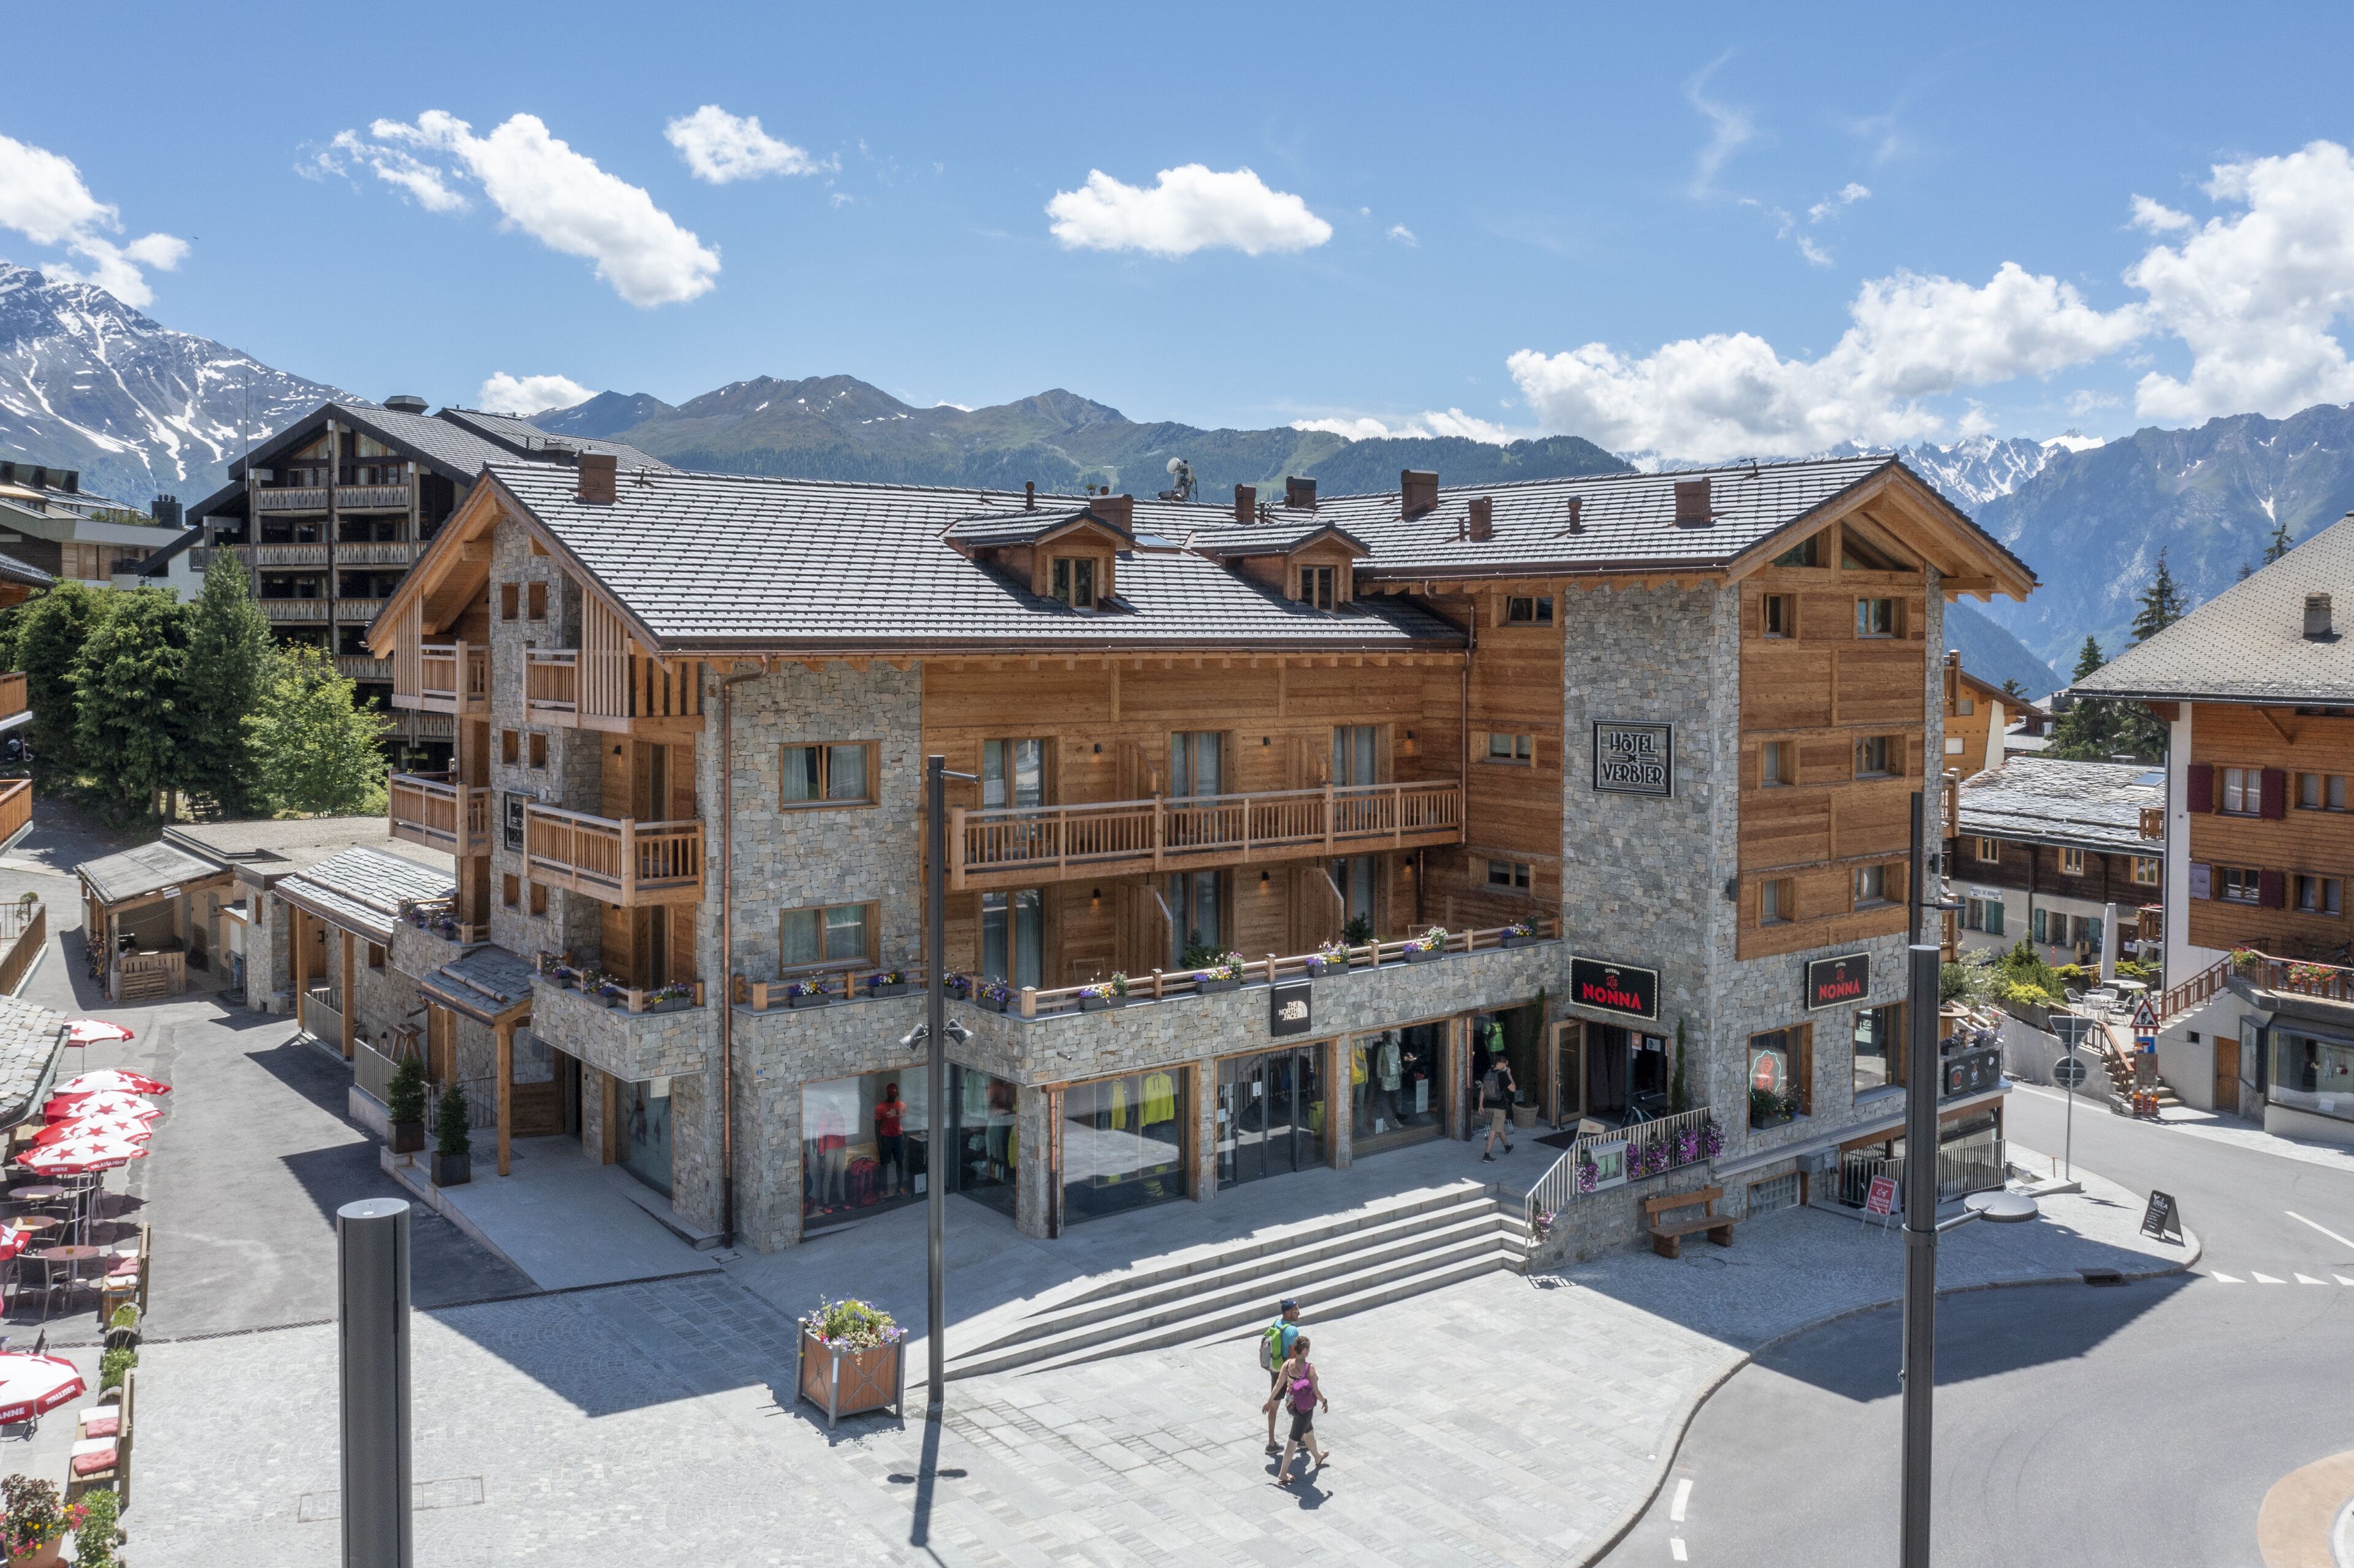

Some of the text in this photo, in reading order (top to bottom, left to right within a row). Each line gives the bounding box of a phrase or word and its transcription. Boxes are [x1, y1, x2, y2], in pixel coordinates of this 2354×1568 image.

[1610, 733, 1657, 753] HÔTEL
[1628, 754, 1639, 763] DE
[1602, 763, 1664, 785] VERBIER
[1606, 975, 1618, 990] La
[1819, 976, 1861, 1001] NONNA
[1287, 1000, 1298, 1009] THE
[1583, 982, 1642, 1010] NONNA
[1279, 1007, 1298, 1016] NORTH
[45, 1385, 76, 1405] WALLISER
